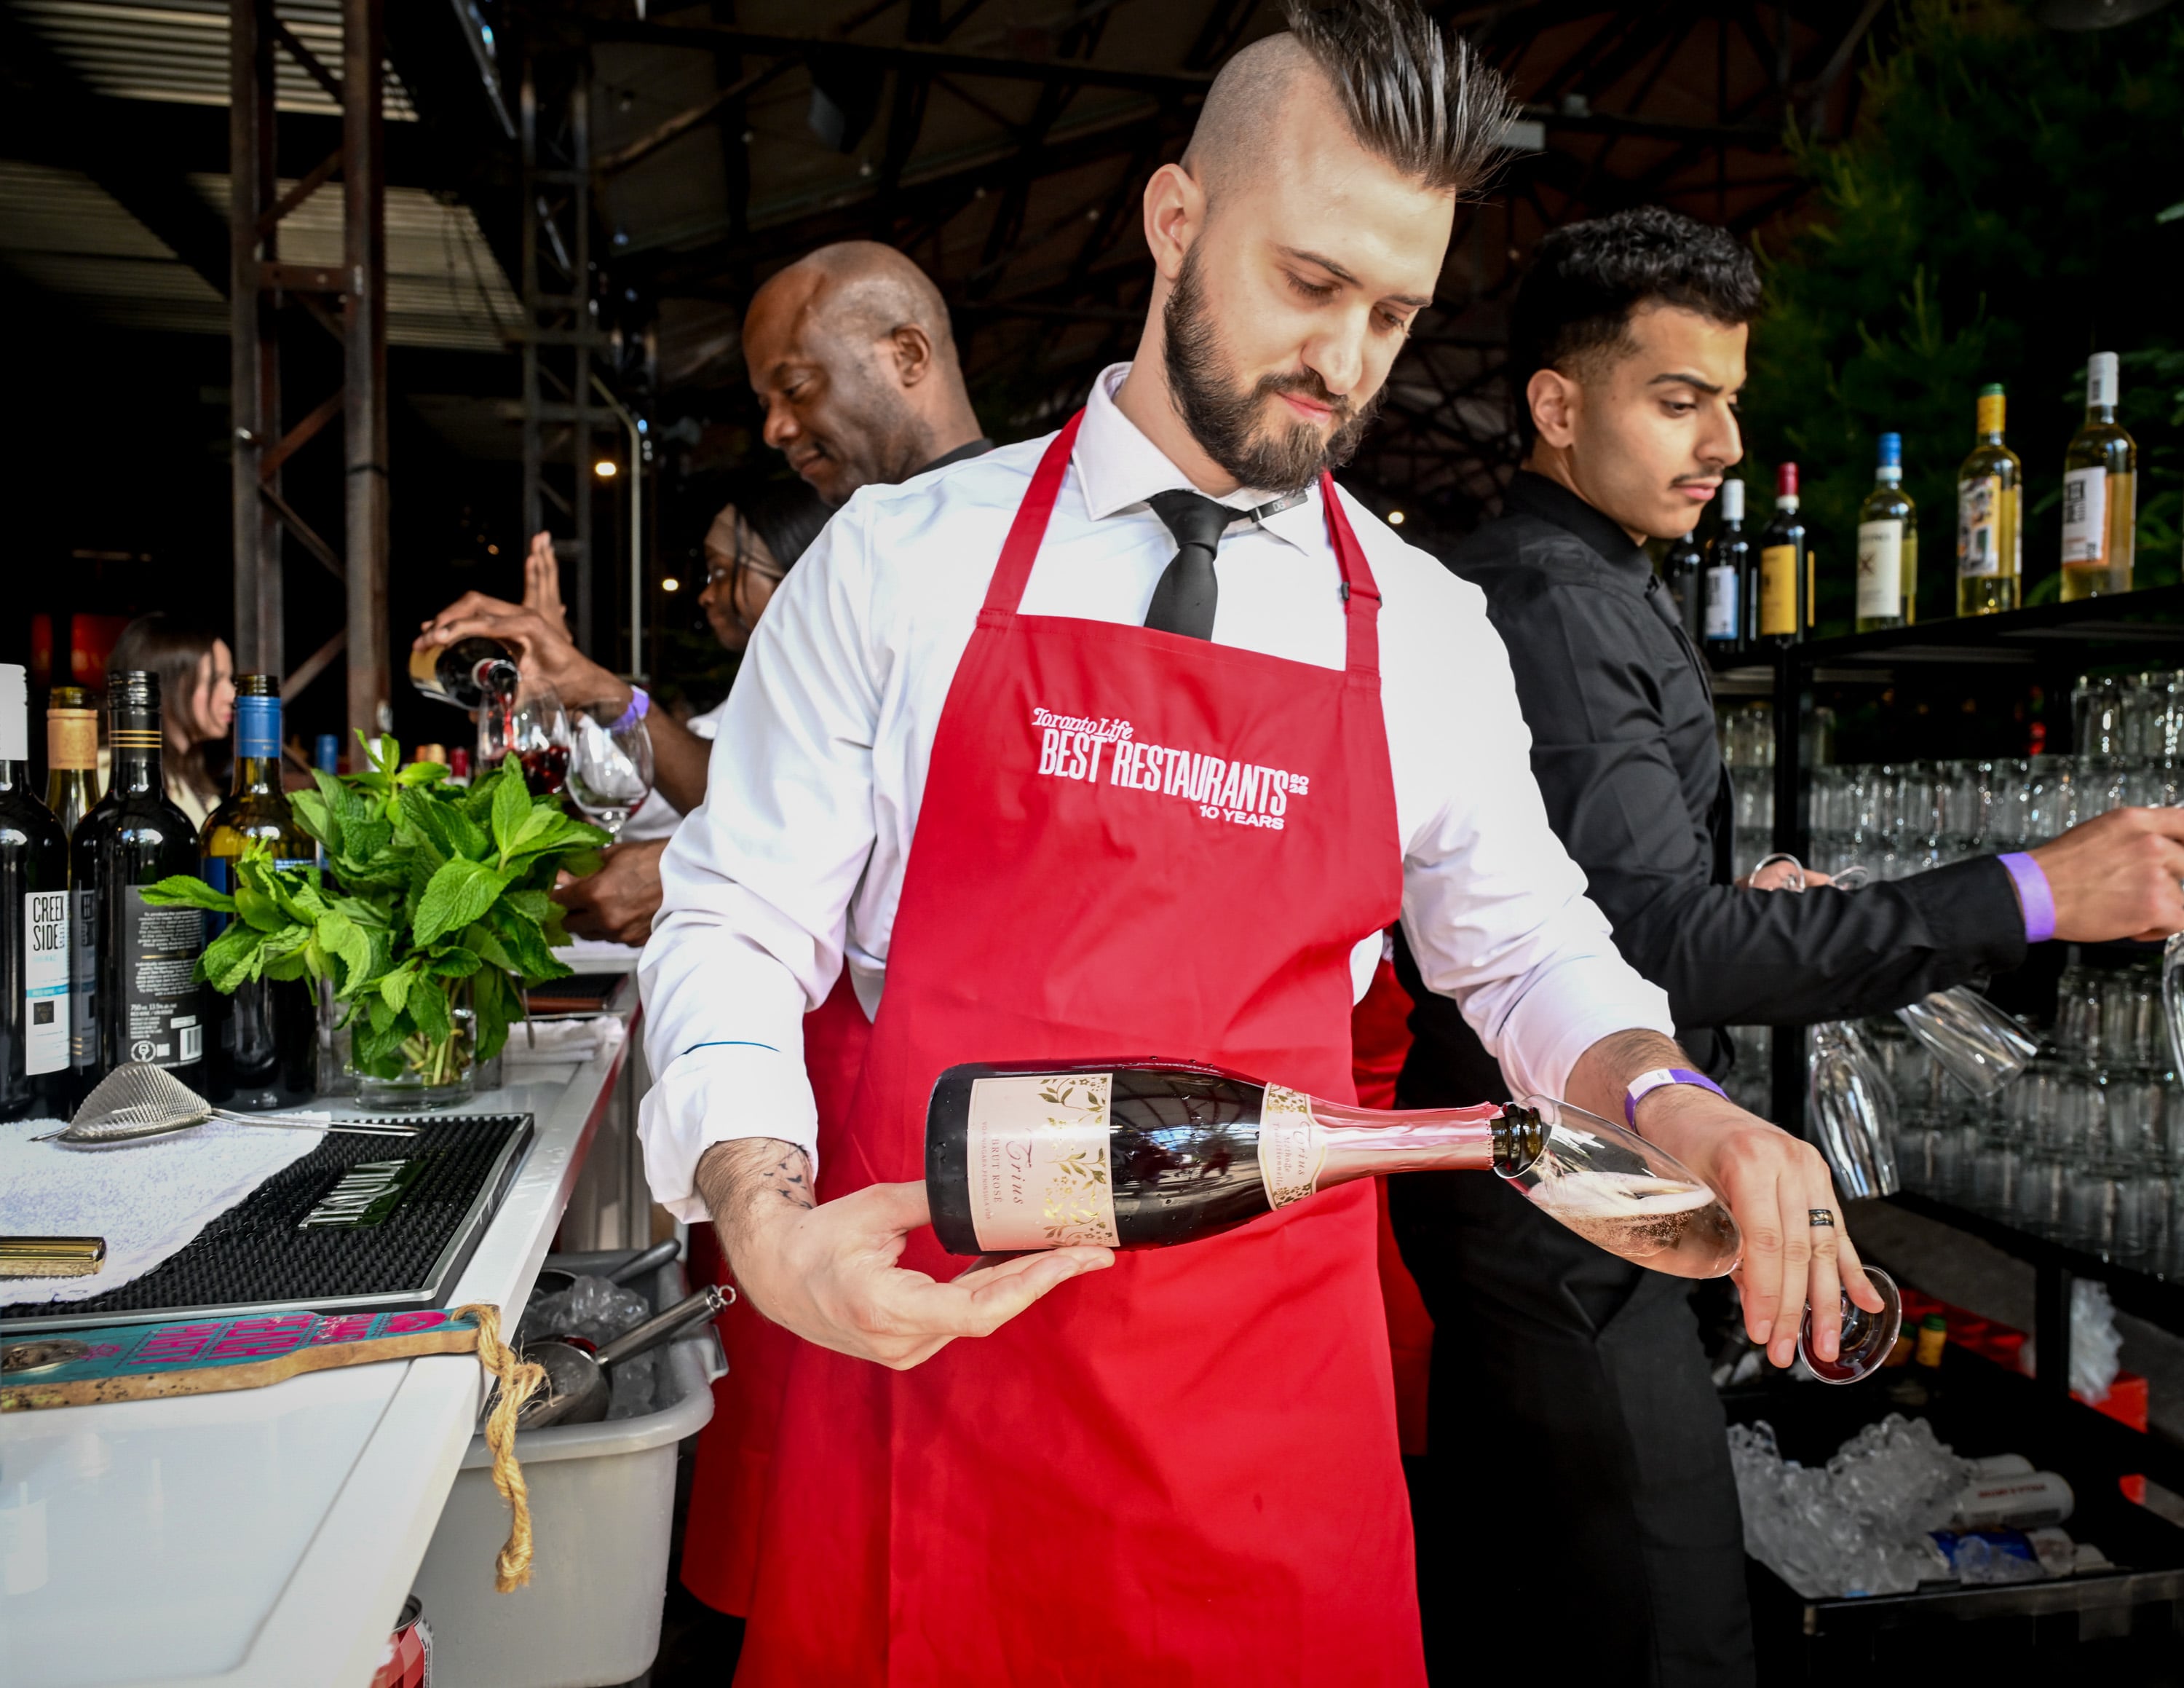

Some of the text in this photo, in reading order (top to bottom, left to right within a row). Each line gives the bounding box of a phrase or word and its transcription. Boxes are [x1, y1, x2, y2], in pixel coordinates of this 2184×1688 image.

[1031, 707, 1134, 743] Toronto Life
[1038, 728, 1289, 816] BEST RESTAURANTS
[1199, 804, 1285, 830] 10 YEARS
[33, 896, 64, 923] CREEK
[33, 923, 58, 951] SIDE
[991, 1138, 1000, 1170] BRUT
[1005, 1127, 1032, 1204] Trius
[1292, 1121, 1313, 1176] Trius
[298, 1159, 410, 1230] TEQUILA
[127, 1322, 223, 1365] PARTY
[205, 1314, 315, 1360] BEACH
